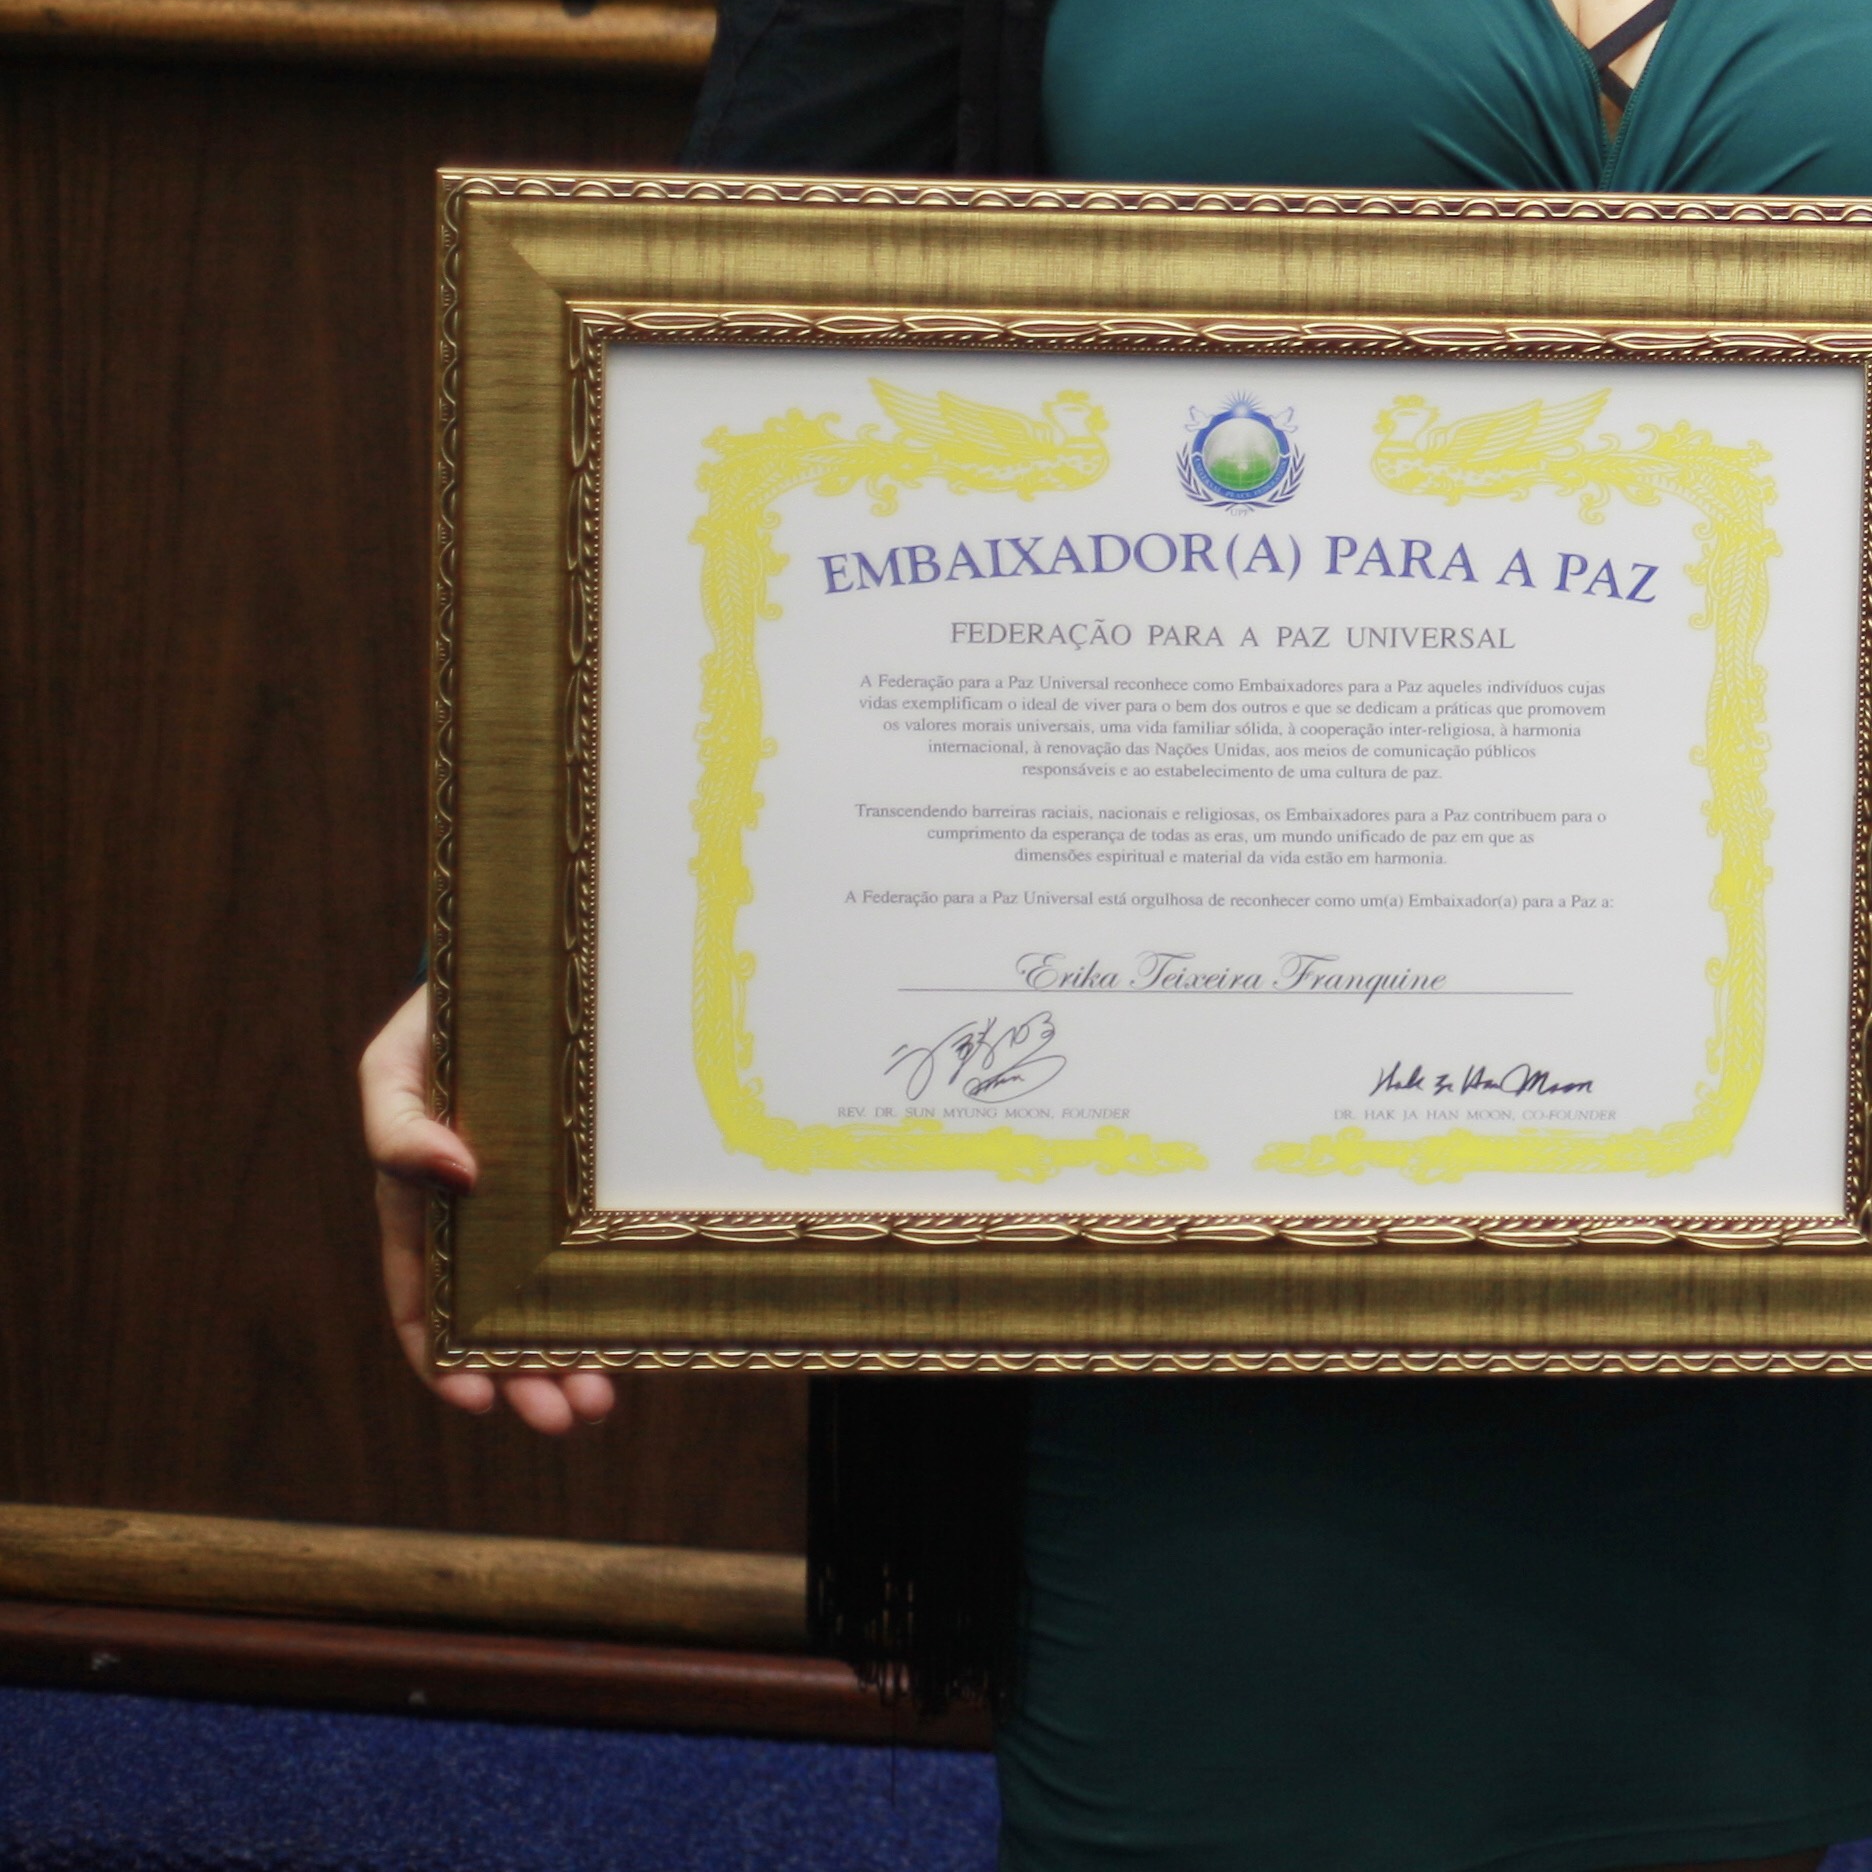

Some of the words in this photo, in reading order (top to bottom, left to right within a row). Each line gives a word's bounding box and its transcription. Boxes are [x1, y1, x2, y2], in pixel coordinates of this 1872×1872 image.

[818, 532, 1302, 595] EMBAIXADOR(A)
[1325, 535, 1480, 584] PARA
[1497, 548, 1536, 589] A
[1553, 551, 1659, 604] PAZ
[950, 618, 1132, 651] FEDERAÇÃO
[1147, 624, 1223, 647] PARA
[1240, 626, 1259, 647] A
[1276, 625, 1330, 648] PAZ
[1346, 626, 1515, 649] UNIVERSAL
[882, 720, 900, 731] os
[904, 717, 957, 731] valores
[961, 718, 1012, 732] morais
[1015, 718, 1094, 734] universais,
[1099, 722, 1131, 734] uma
[1136, 719, 1168, 735] vida
[1172, 719, 1231, 735] familiar
[1234, 720, 1283, 736] sólida,
[1287, 721, 1296, 735] à
[1299, 722, 1384, 740] cooperação
[1388, 720, 1495, 740] inter-religiosa,
[1499, 722, 1508, 736] à
[1511, 722, 1581, 737] harmonia
[1013, 847, 1092, 862] dimensões
[1096, 848, 1165, 866] espiritual
[1169, 853, 1178, 863] e
[1182, 849, 1242, 864] material
[1246, 849, 1264, 864] da
[1269, 850, 1301, 864] vida
[1304, 851, 1343, 864] estão
[1346, 853, 1370, 865] em
[1374, 850, 1447, 865] harmonia.
[1015, 952, 1118, 990] Erika
[1131, 951, 1262, 990] Teixeira
[1272, 953, 1446, 1004] Franquine
[837, 1107, 866, 1118] REV.
[875, 1107, 896, 1118] DR.
[904, 1107, 935, 1118] SUN
[943, 1108, 998, 1119] MYUNG
[1005, 1108, 1054, 1120] MOON,
[1061, 1108, 1129, 1119] FOUNDER
[1333, 1110, 1354, 1121] DR.
[1364, 1110, 1395, 1121] HAK
[1400, 1110, 1418, 1121] JA
[1426, 1110, 1458, 1121] HAN
[1466, 1110, 1515, 1122] MOON,
[1522, 1110, 1616, 1121] CO-FOUNDER
